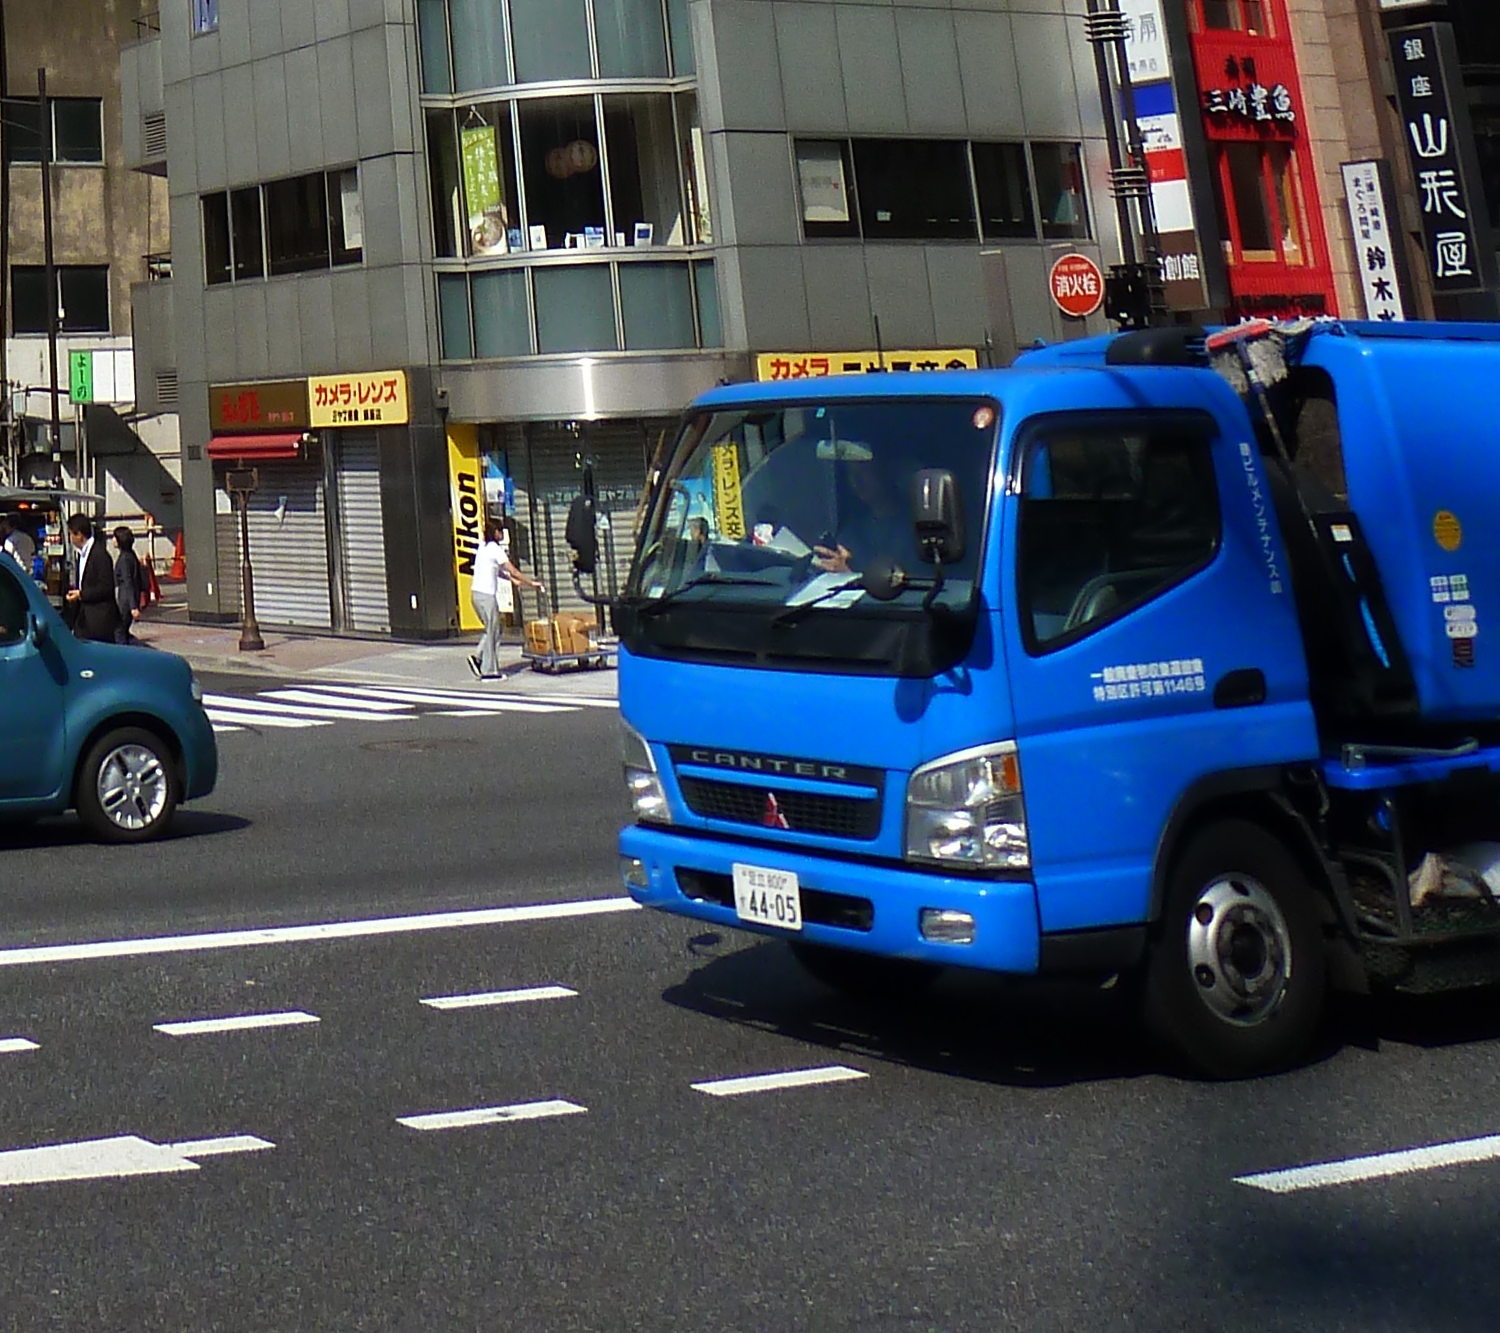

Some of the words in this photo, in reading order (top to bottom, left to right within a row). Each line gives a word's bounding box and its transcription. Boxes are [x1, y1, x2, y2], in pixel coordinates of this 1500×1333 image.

[1055, 272, 1098, 298] 消火栓
[770, 358, 829, 380] カメラ
[315, 379, 397, 407] カメラ・レンズ
[456, 471, 479, 579] Nikon
[692, 750, 847, 780] CANTER
